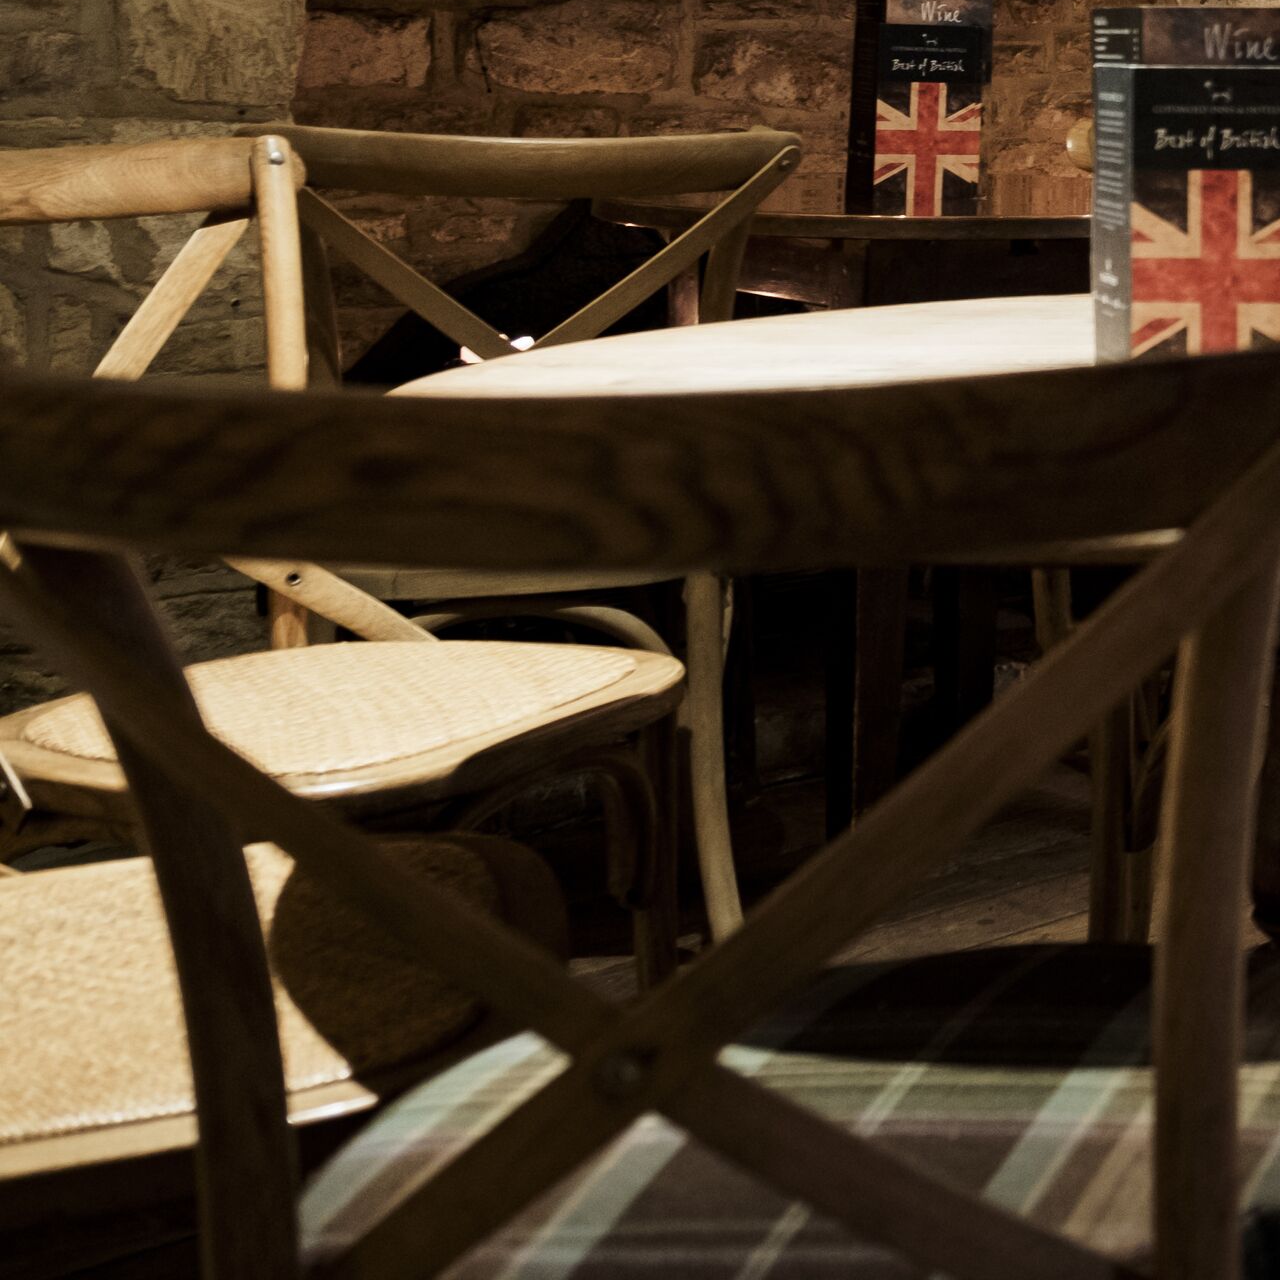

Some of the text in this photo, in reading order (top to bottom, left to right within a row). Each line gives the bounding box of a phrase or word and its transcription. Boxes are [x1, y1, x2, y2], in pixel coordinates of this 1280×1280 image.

[921, 0, 962, 23] Wine
[1203, 22, 1278, 61] Wine
[891, 59, 916, 71] Best
[918, 58, 928, 77] of
[1153, 127, 1195, 151] Best
[1199, 124, 1217, 160] of
